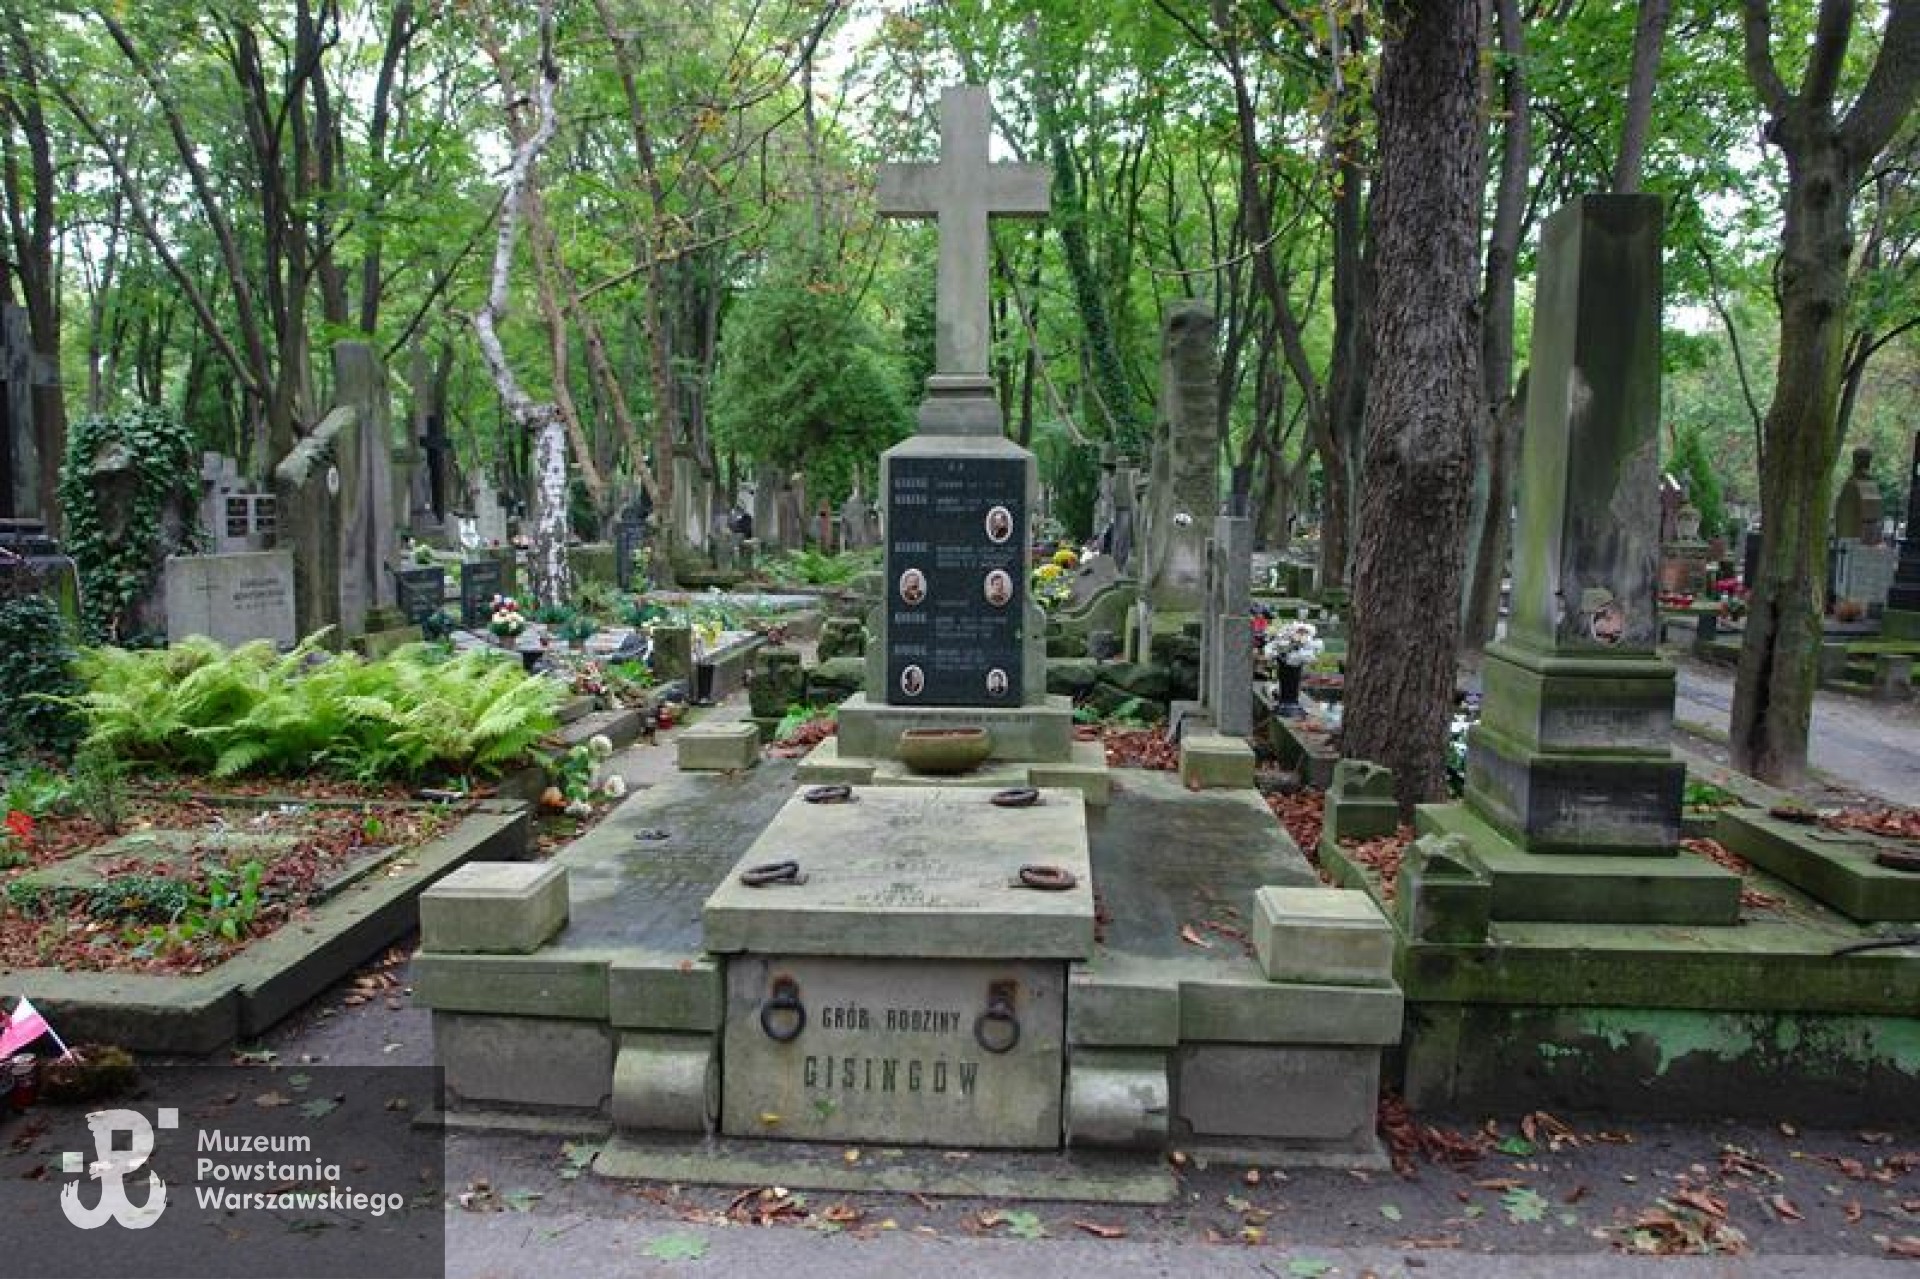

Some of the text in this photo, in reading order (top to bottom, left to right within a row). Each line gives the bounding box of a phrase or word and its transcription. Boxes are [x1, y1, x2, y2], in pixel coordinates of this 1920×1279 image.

[823, 1001, 960, 1034] GRÓB RODZINY
[805, 1052, 979, 1094] GISINGÓW
